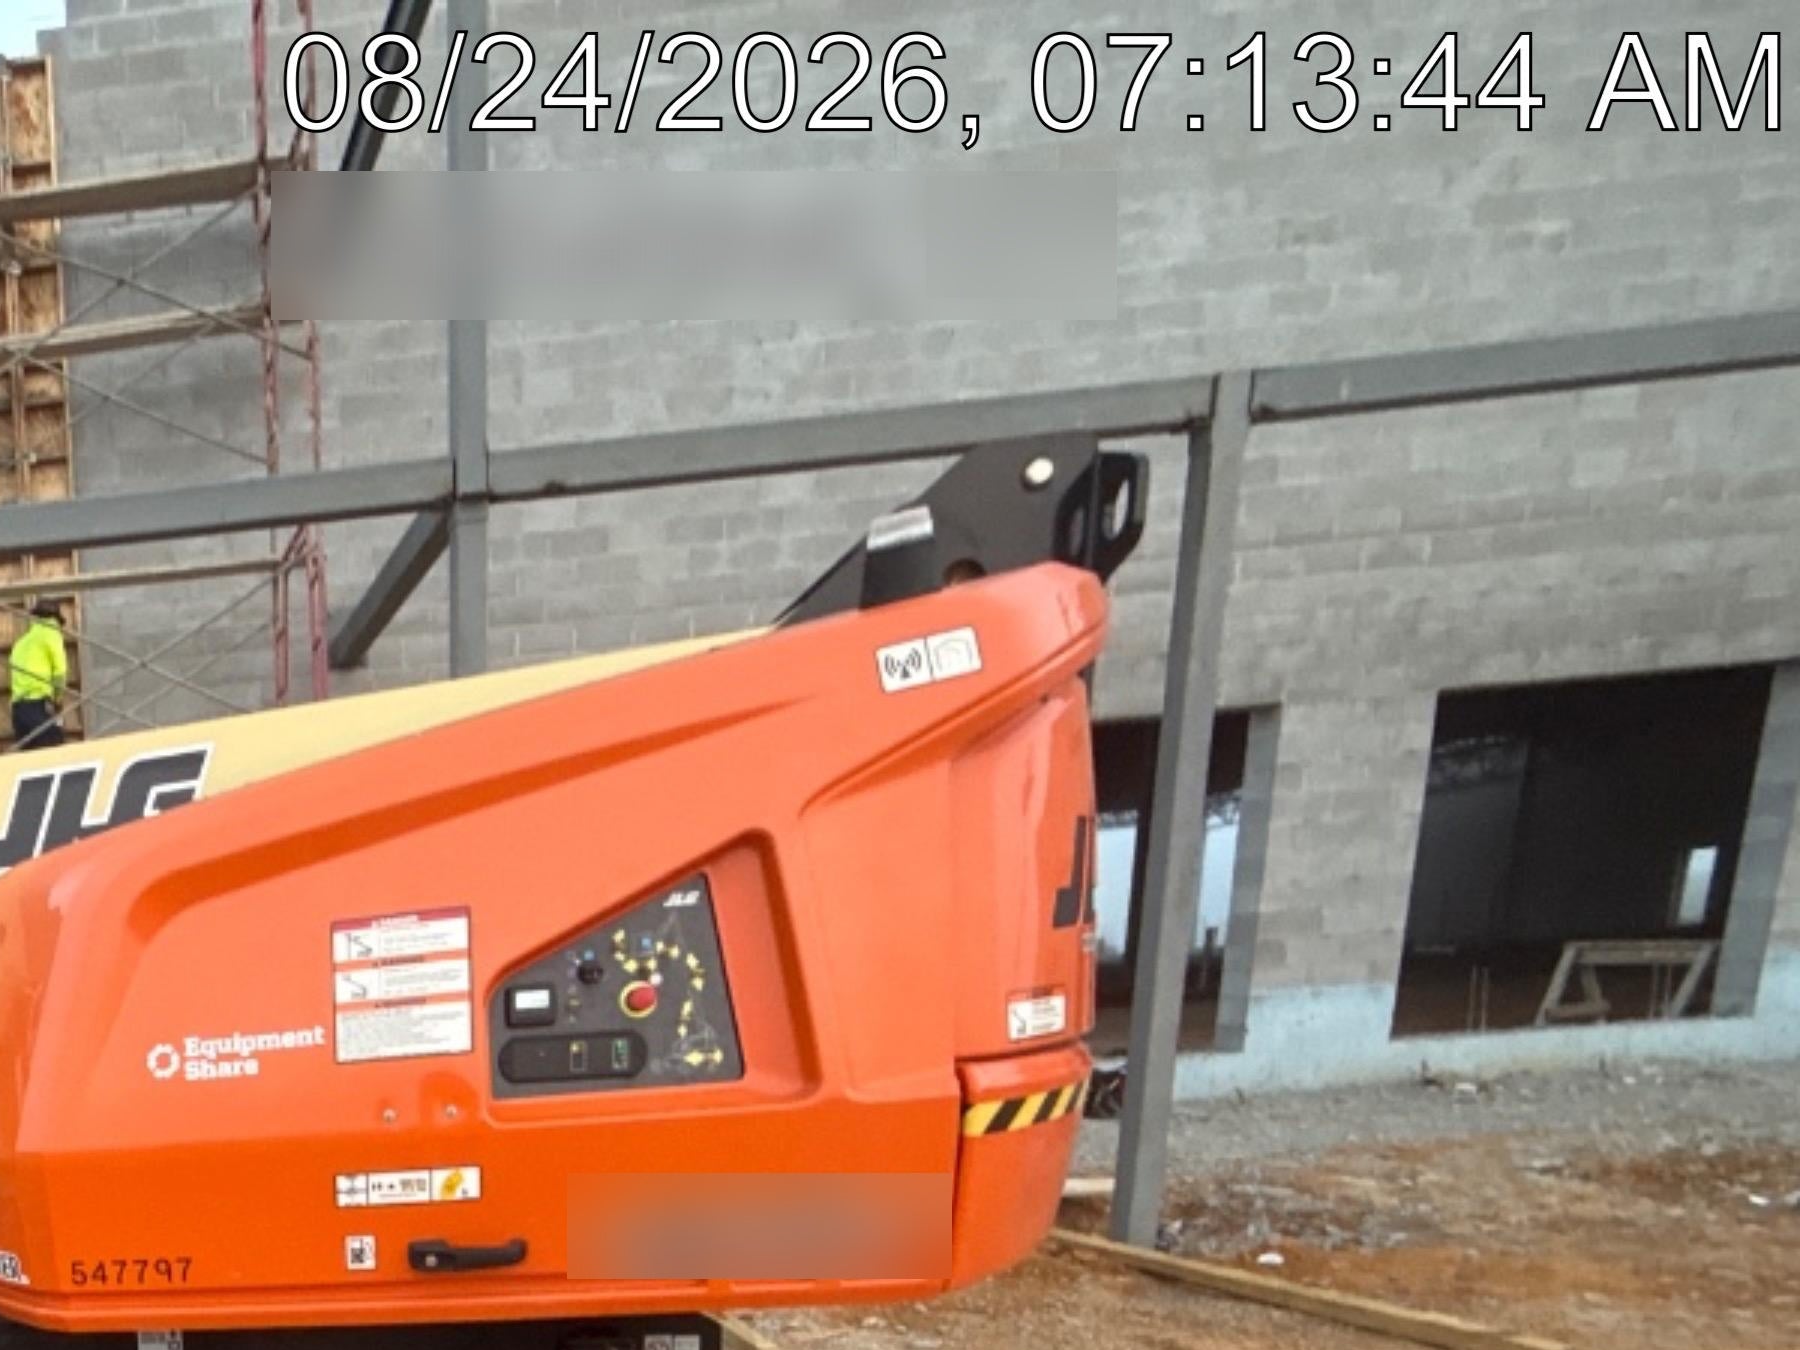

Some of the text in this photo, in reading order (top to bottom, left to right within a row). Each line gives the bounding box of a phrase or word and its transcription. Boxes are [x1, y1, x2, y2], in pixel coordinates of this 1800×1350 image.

[183, 1024, 326, 1060] Equipment
[184, 1058, 260, 1081] Share
[70, 1256, 193, 1286] 547797
